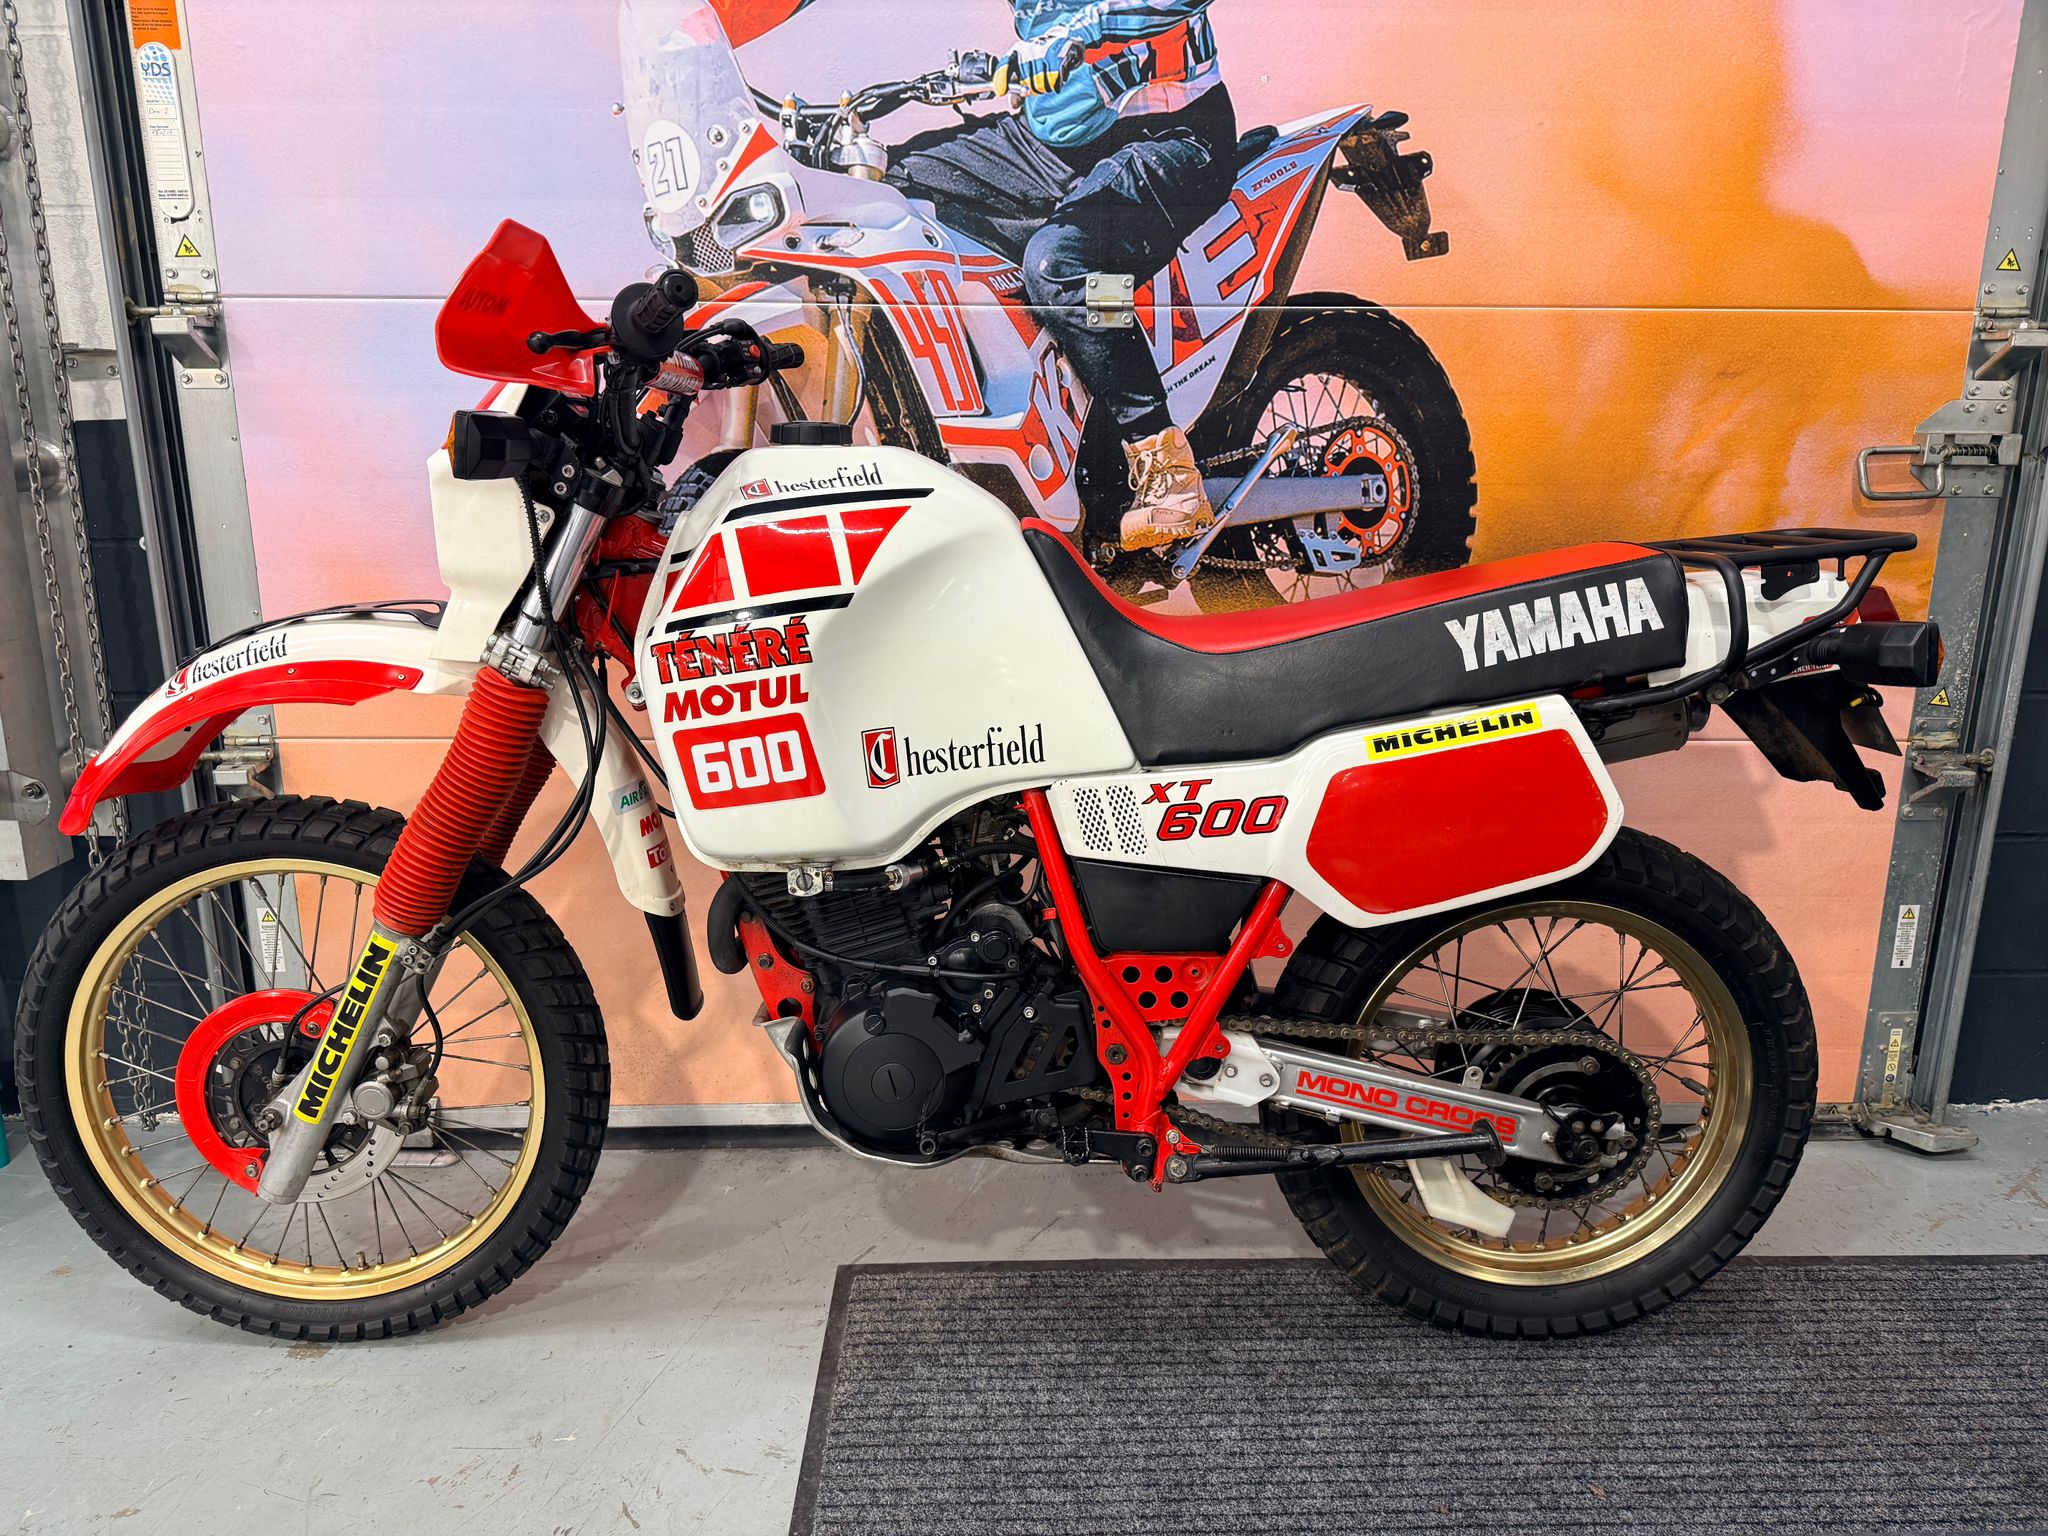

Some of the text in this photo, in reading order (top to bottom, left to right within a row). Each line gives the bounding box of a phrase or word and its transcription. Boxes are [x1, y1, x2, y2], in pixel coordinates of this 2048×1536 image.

[141, 63, 171, 77] YDS
[647, 136, 688, 197] 21
[1173, 355, 1216, 389] THE DREAM
[1444, 577, 1665, 672] YAMAHA
[651, 615, 813, 684] TÉNÉRÉ
[664, 673, 809, 723] MOTUL
[1373, 709, 1534, 753] MICHELIN
[691, 729, 807, 794] 600
[1142, 779, 1213, 805] XT
[1157, 795, 1289, 841] 600
[297, 941, 391, 1119] MICHELIN
[1297, 1071, 1399, 1108] MONO
